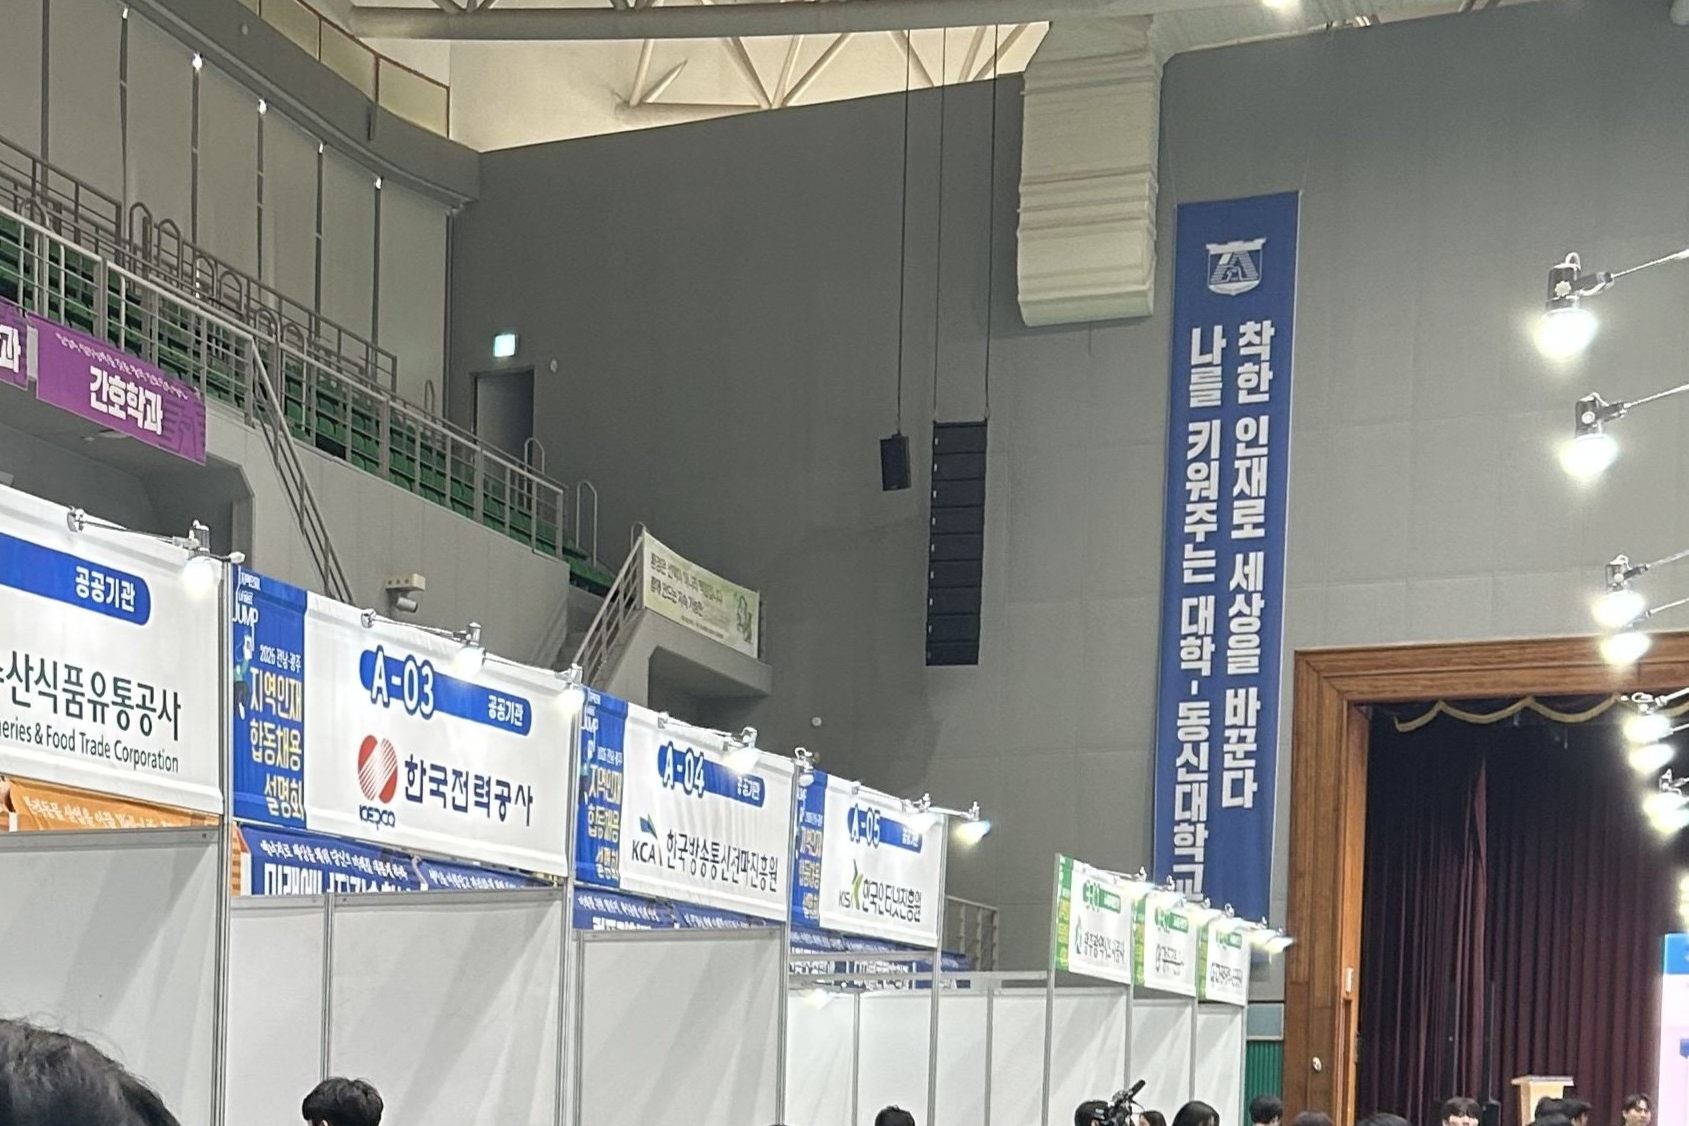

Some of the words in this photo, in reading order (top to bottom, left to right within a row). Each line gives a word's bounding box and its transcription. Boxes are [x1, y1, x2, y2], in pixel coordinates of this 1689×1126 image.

[1189, 324, 1227, 409] 나를
[1237, 320, 1275, 404] 착한
[90, 366, 163, 435] 간호학과
[1182, 419, 1221, 584] 키워주는
[1231, 415, 1269, 540] 인재로
[74, 565, 135, 612] 공공기관
[1227, 551, 1265, 675] 세상을
[250, 667, 302, 722] 지역인재
[371, 649, 434, 715] A-03
[488, 695, 524, 727] 공공기관
[34, 722, 43, 746] &
[46, 725, 75, 752] Food
[79, 732, 111, 759] Trade
[114, 740, 179, 773] Corporation
[250, 718, 302, 772] 합동채용
[663, 744, 705, 794] A-04
[1222, 687, 1261, 809] 바꾼다
[264, 773, 305, 821] 설명회
[404, 754, 533, 827] 한국전력공사
[632, 840, 657, 865] KCA
[851, 804, 881, 847] A-05
[667, 829, 778, 892] 한국방송통신전파진흥원
[863, 879, 922, 922] 한국인터넷진흥원
